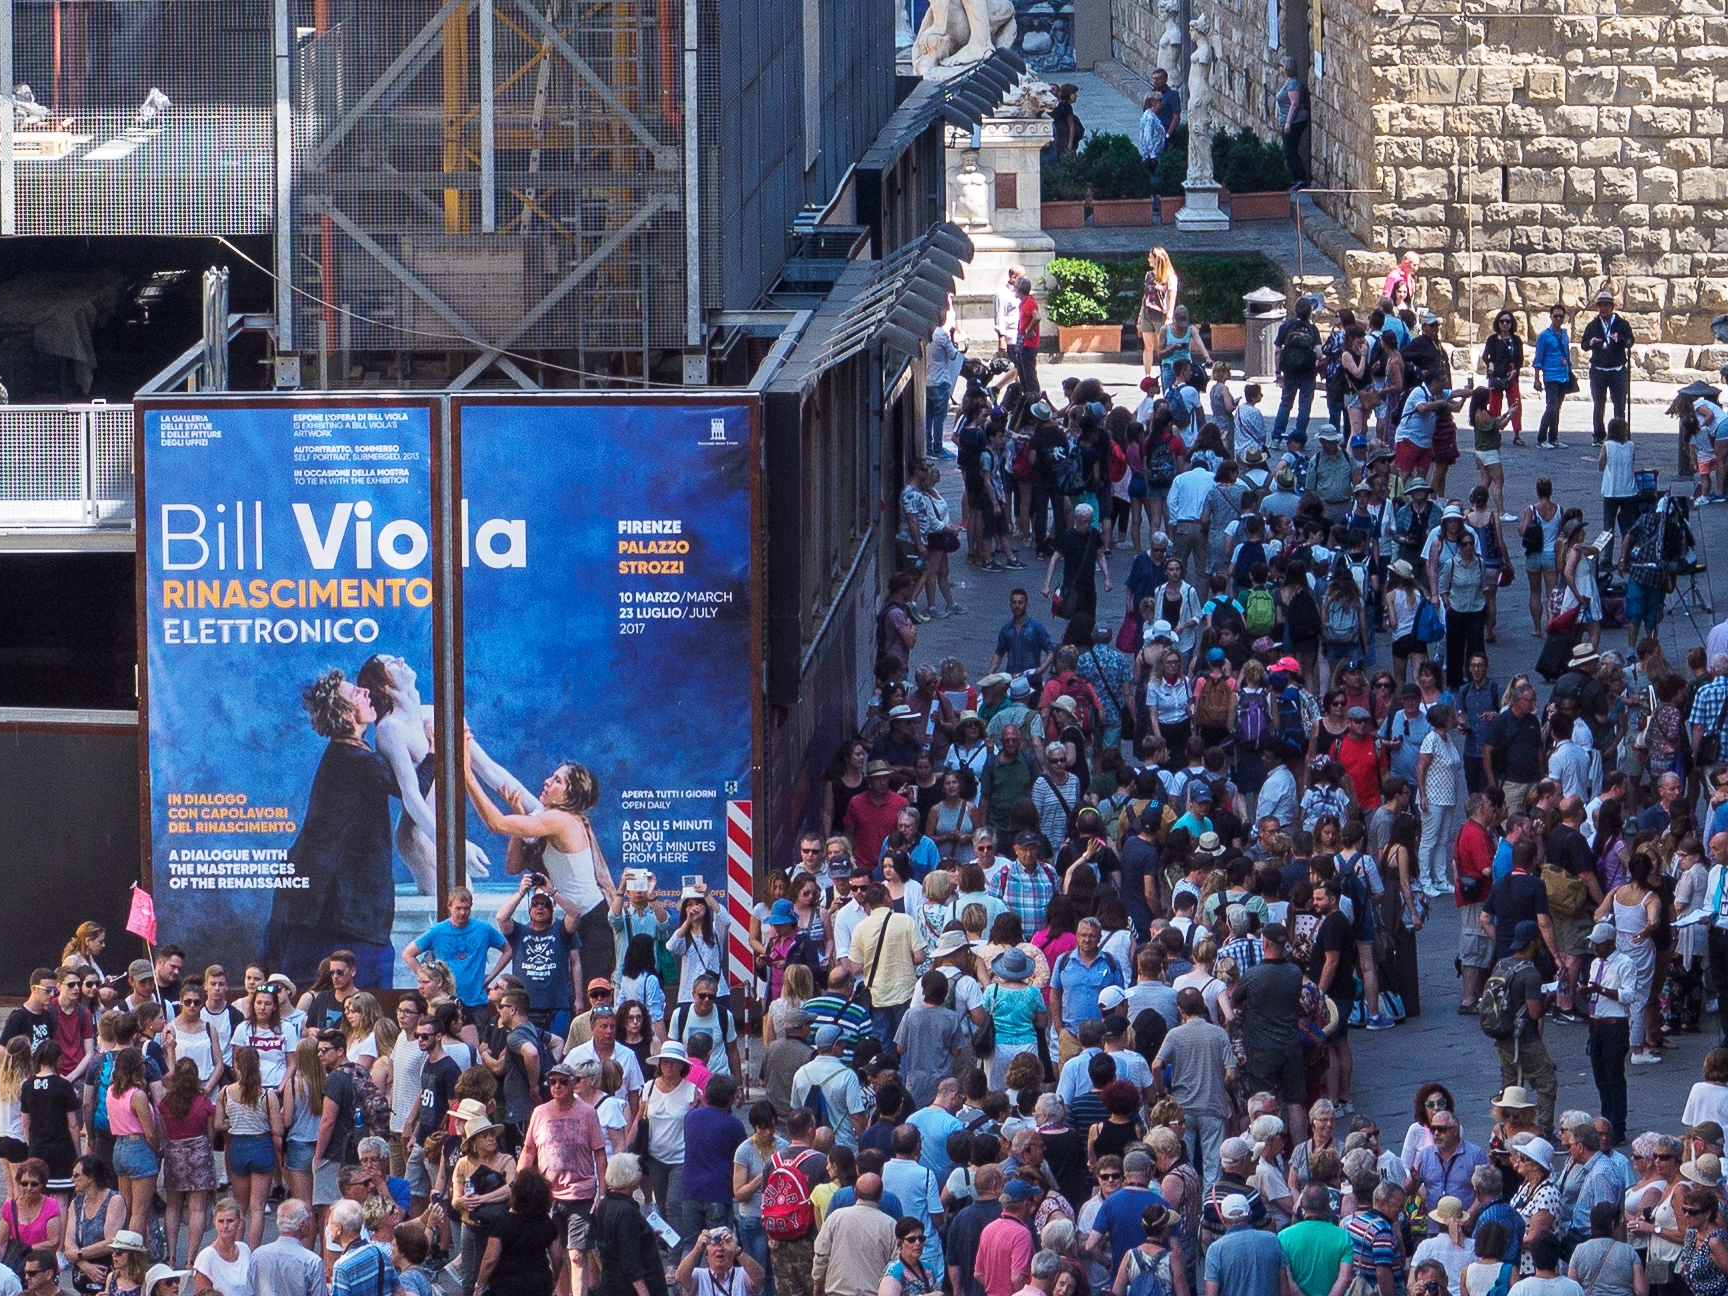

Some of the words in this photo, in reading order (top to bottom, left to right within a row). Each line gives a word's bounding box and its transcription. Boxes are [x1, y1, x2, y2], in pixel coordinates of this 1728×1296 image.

[377, 468, 409, 476] MOSTRA
[618, 520, 682, 534] FIRENZE
[161, 501, 263, 570] Bill
[618, 540, 690, 554] PALAZZO
[618, 560, 684, 574] STROZZI
[163, 577, 433, 608] RINASCIMENTO
[618, 592, 632, 603] 10
[619, 607, 633, 619] 23
[163, 617, 379, 644] ELETTRONICO
[619, 623, 646, 634] 2017
[167, 793, 181, 805] IN
[184, 793, 248, 805] DIALOGO
[621, 790, 654, 798] APERTA
[655, 790, 679, 798] TUTTI
[685, 790, 716, 798] GIORNI
[622, 801, 646, 809] OPEN
[647, 801, 671, 809] DAILY
[168, 807, 198, 819] CON
[201, 807, 288, 819] CAPOLAVORI
[168, 822, 193, 833] DEL
[196, 821, 297, 833] RINASCIMENTO
[622, 821, 631, 830] A
[633, 820, 660, 830] SOLI
[662, 820, 670, 830] 5
[672, 820, 713, 830] MINUTI
[622, 831, 639, 841] DA
[642, 831, 664, 842] QUI
[622, 842, 654, 852] ONLY
[656, 842, 663, 852] 5
[666, 841, 716, 852] MINUTES
[168, 849, 179, 861] A
[181, 849, 250, 861] DIALOGUE
[251, 849, 288, 861] WITH
[622, 853, 656, 863] FROM
[659, 852, 689, 862] HERE
[168, 863, 194, 875] THE
[197, 863, 296, 875] MASTERPIECES
[169, 877, 189, 889] OF
[190, 877, 216, 889] THE
[217, 876, 310, 889] RENAISSANCE
